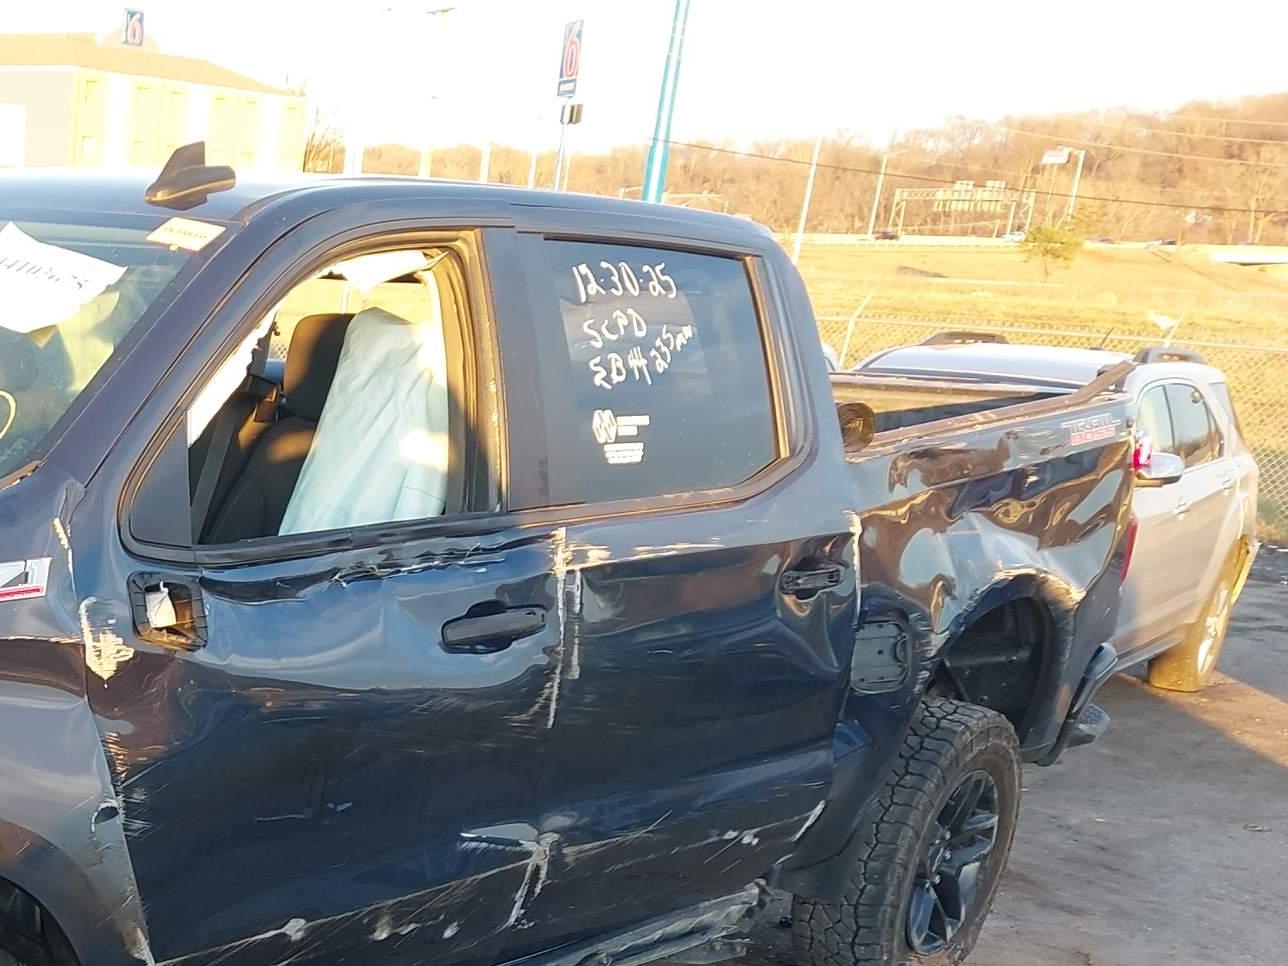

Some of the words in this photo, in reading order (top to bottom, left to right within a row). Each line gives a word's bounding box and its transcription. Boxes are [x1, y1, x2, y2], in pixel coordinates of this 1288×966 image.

[582, 308, 647, 348] SCPD
[1061, 412, 1121, 433] TRAIL
[1071, 425, 1116, 446] BOSS
